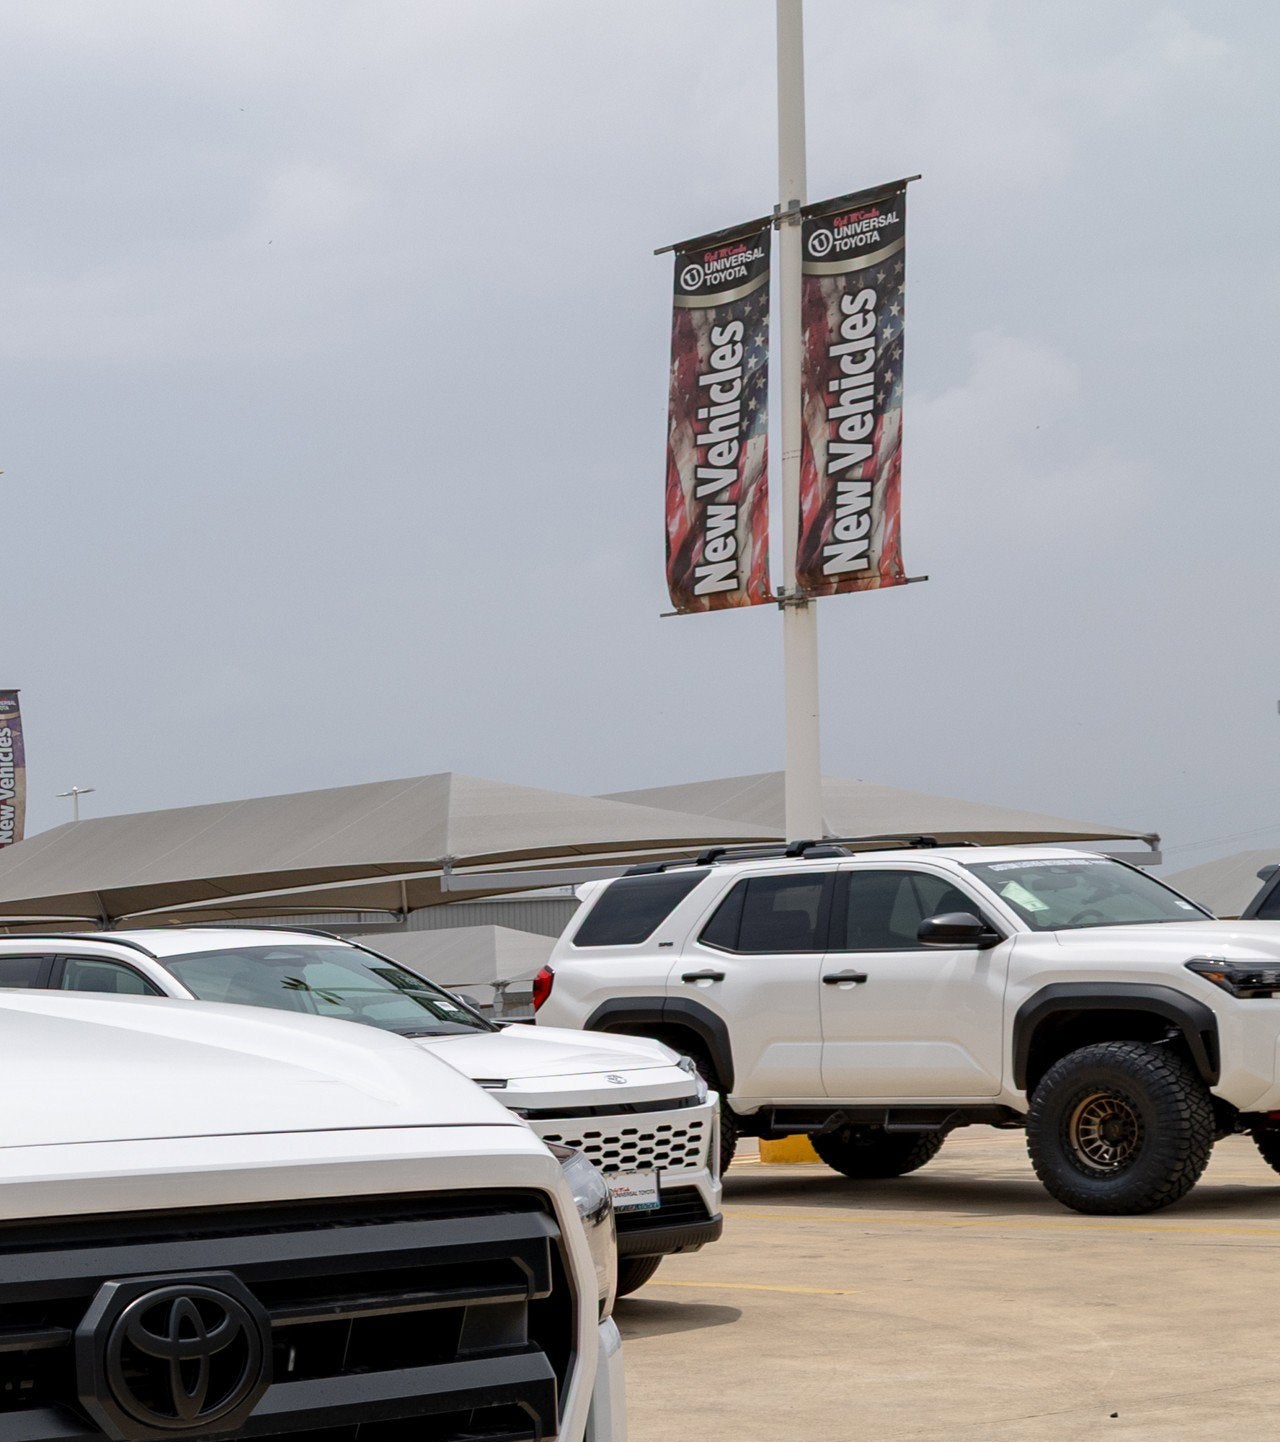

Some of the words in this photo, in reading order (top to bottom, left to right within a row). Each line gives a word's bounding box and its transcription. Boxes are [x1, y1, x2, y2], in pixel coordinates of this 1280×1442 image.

[834, 211, 900, 239] UNIVERSAL
[834, 231, 881, 252] TOYOTA
[704, 246, 765, 274] UNIVERSAL
[704, 265, 748, 286] TOYOTA
[696, 320, 745, 497] Vehicles
[828, 288, 878, 476] Vehicles
[692, 504, 740, 597] New
[823, 480, 873, 577] New
